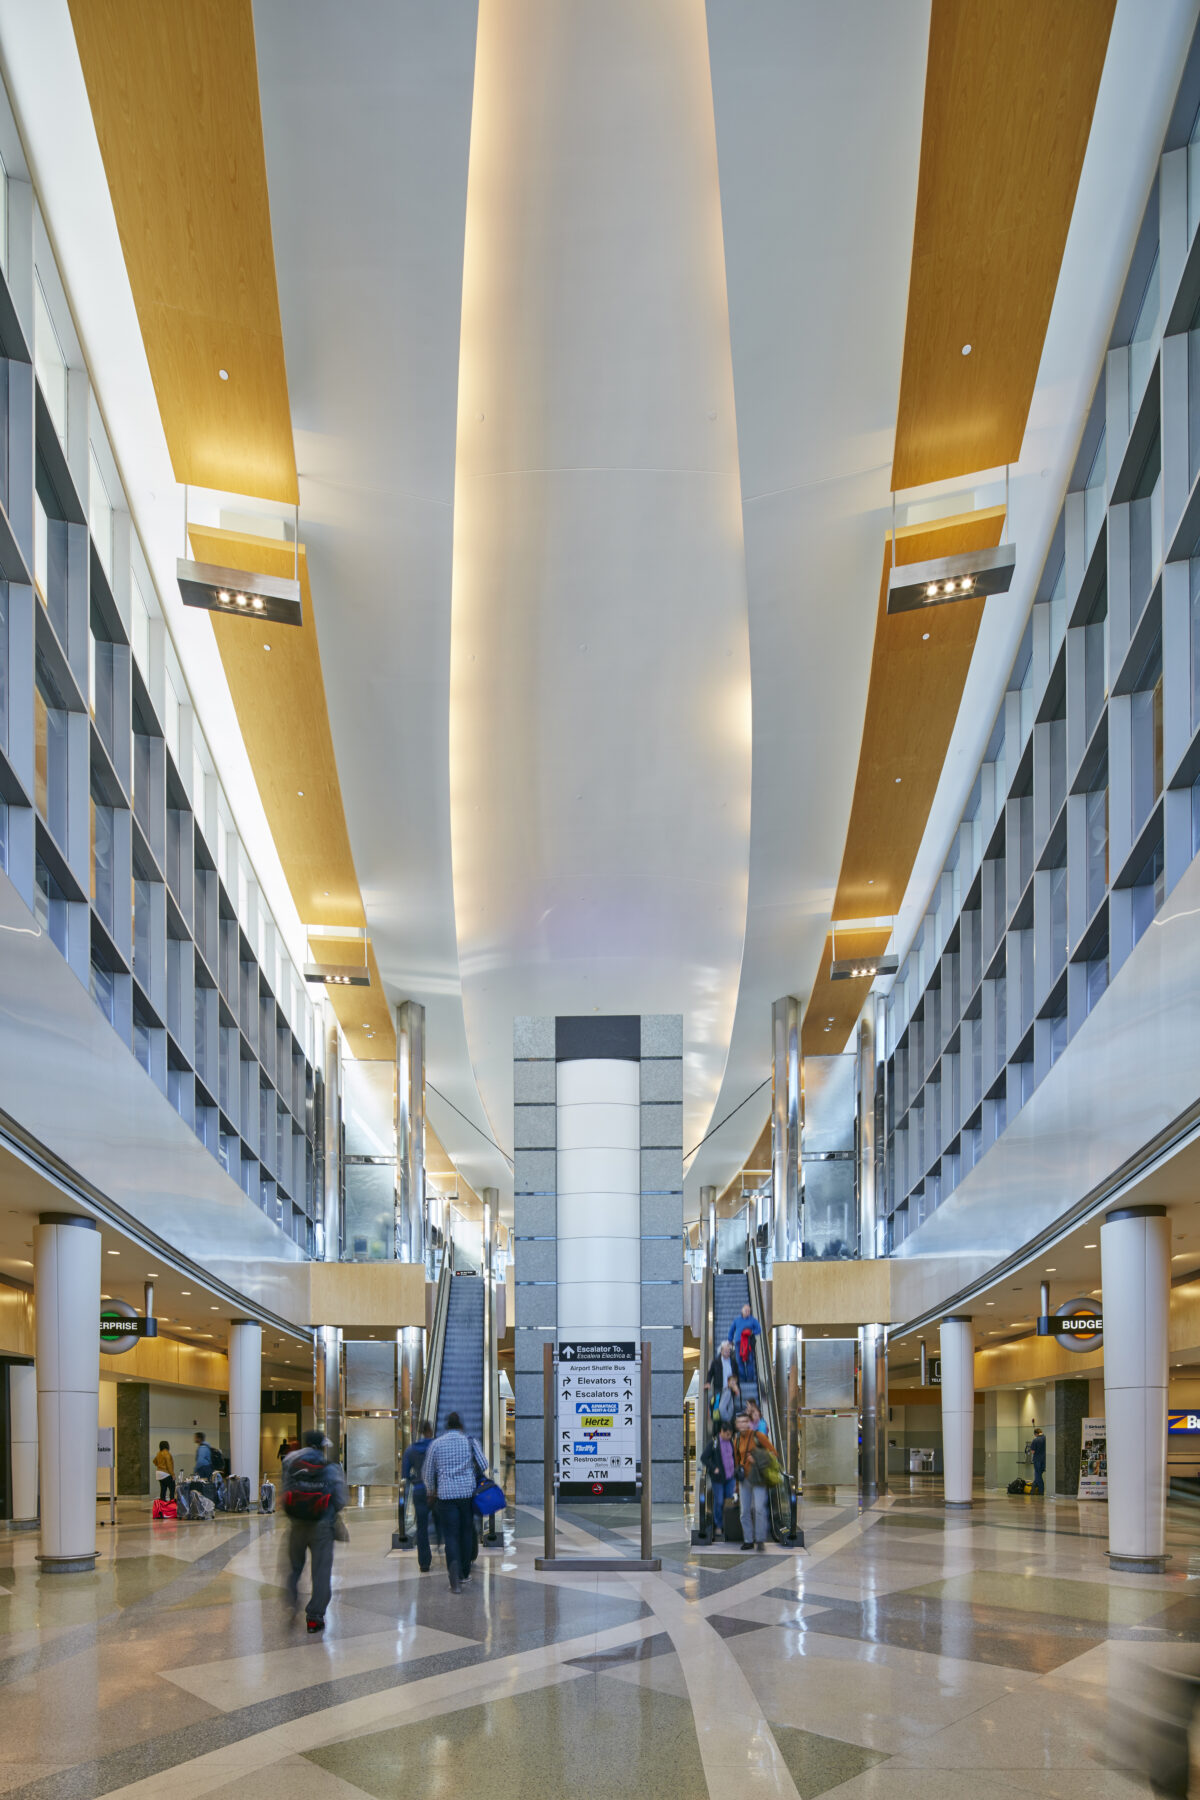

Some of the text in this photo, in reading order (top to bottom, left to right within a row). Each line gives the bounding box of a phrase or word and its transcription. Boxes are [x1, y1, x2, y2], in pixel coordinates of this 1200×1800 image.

[1062, 1320, 1103, 1329] BUDGE
[577, 1345, 611, 1353] Escalator
[577, 1377, 616, 1385] Elevators
[575, 1390, 619, 1398] Escalators
[585, 1418, 610, 1426] Hertz
[587, 1470, 609, 1479] ATM
